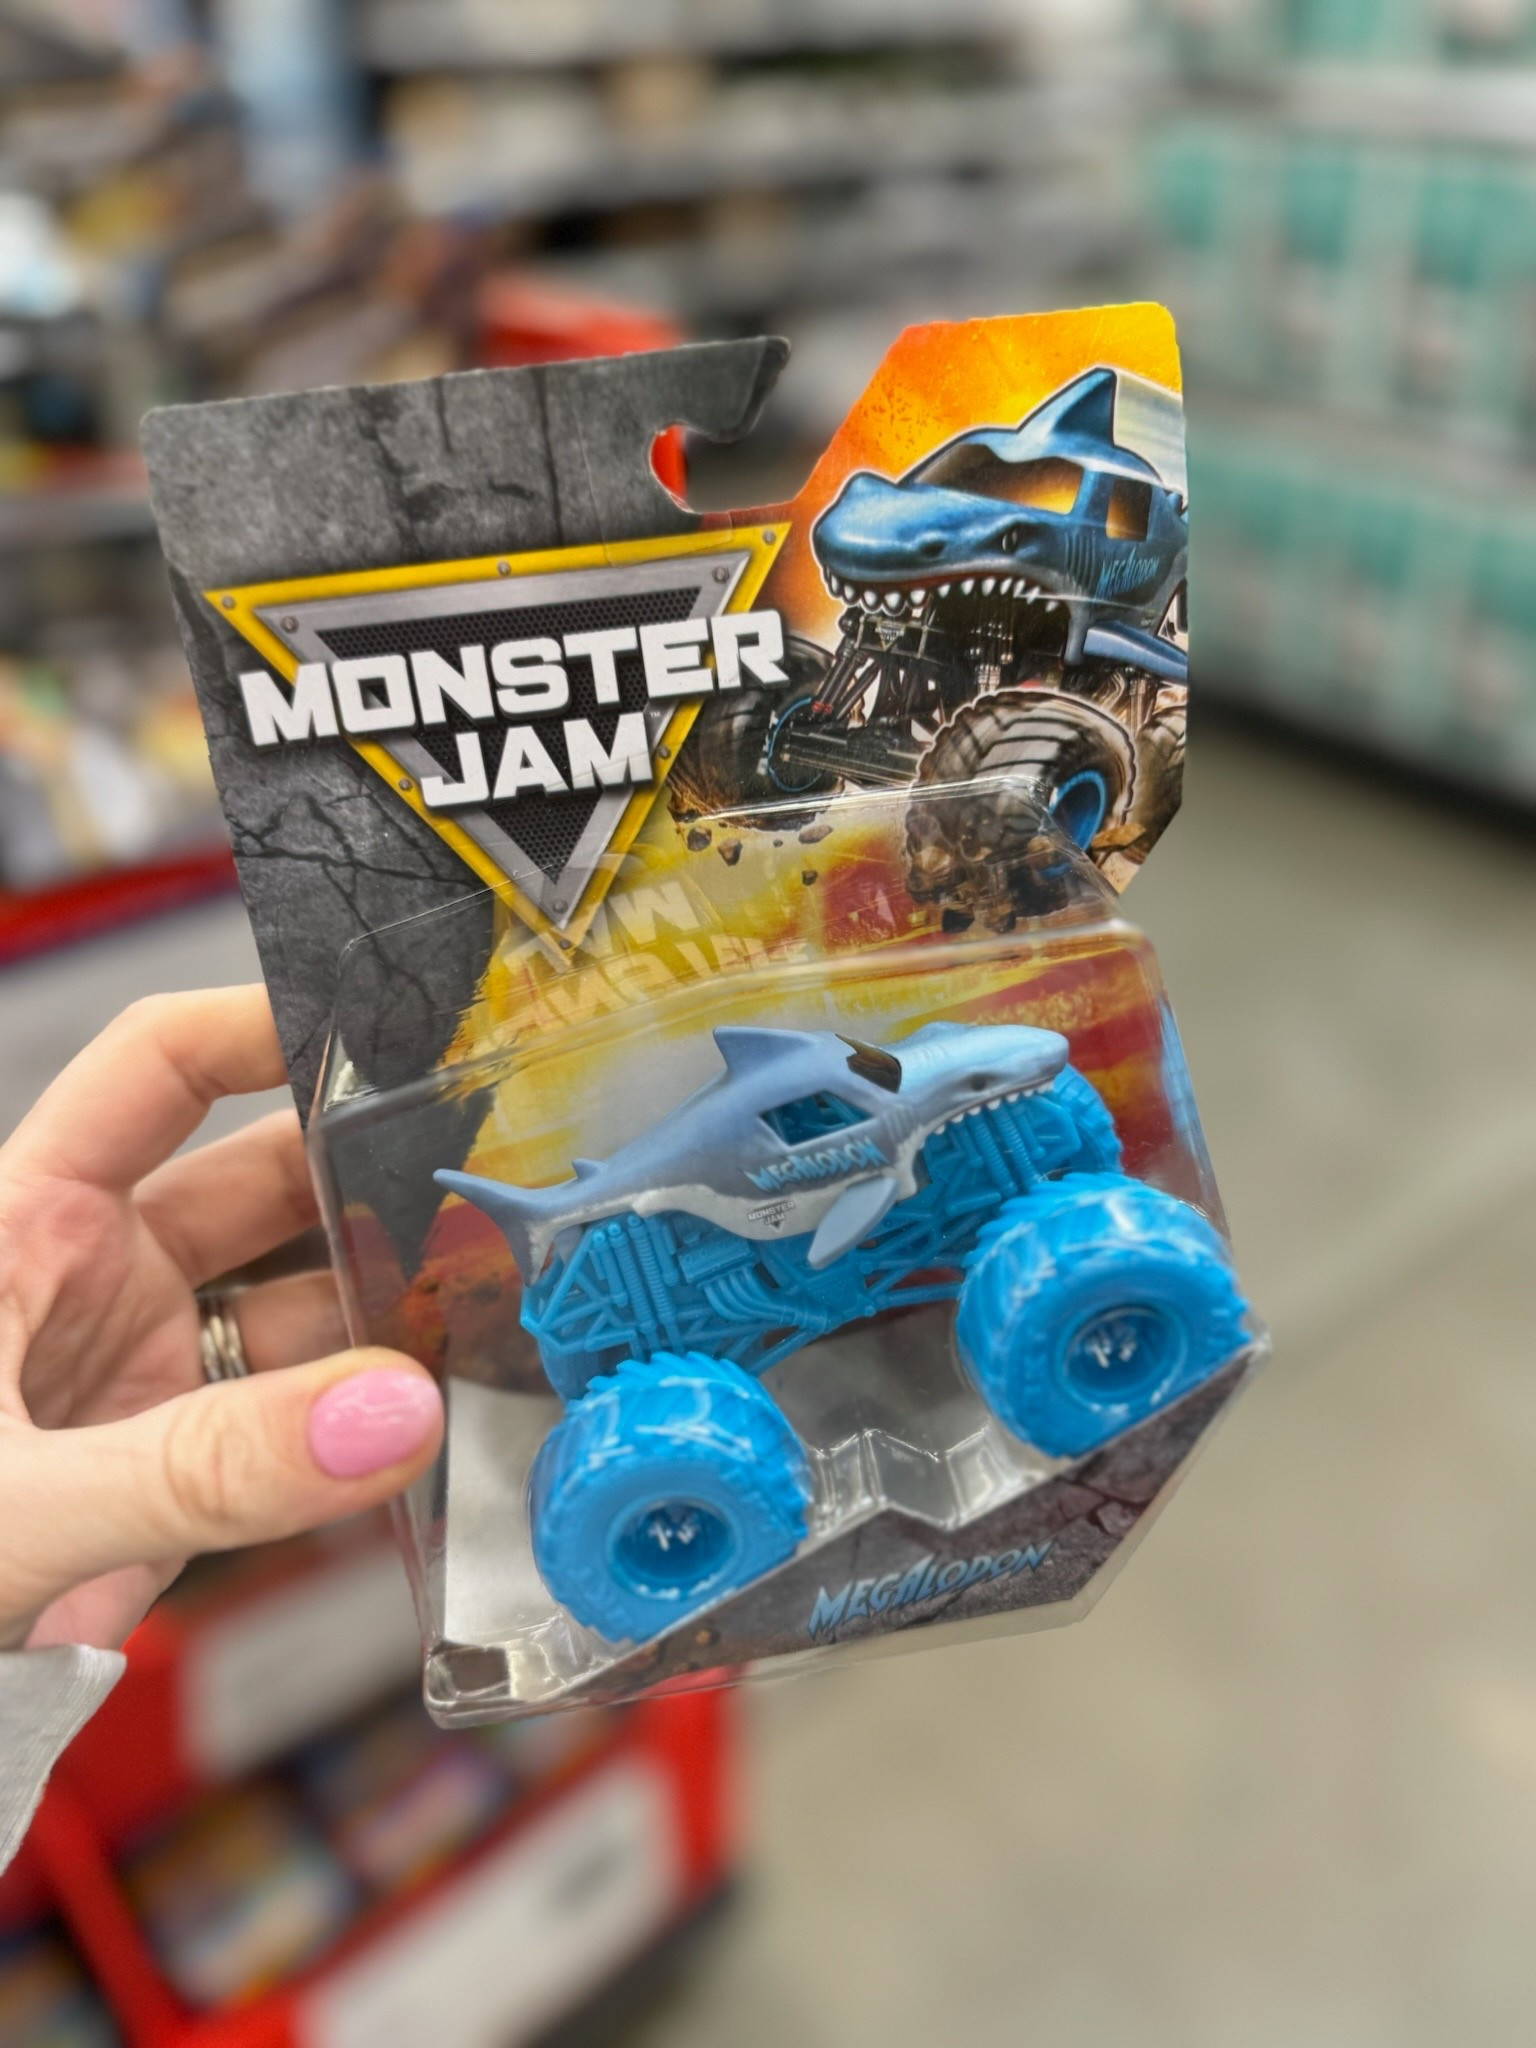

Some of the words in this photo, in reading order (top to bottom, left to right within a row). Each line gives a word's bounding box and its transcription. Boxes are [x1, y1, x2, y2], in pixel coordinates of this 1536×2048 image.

[239, 609, 790, 747] MONSTER
[420, 711, 654, 808] JAM
[742, 1135, 890, 1193] MEGALODON
[747, 1200, 795, 1220] MONSTER
[763, 1212, 786, 1225] JAM
[807, 1540, 1056, 1640] MEGALODON
